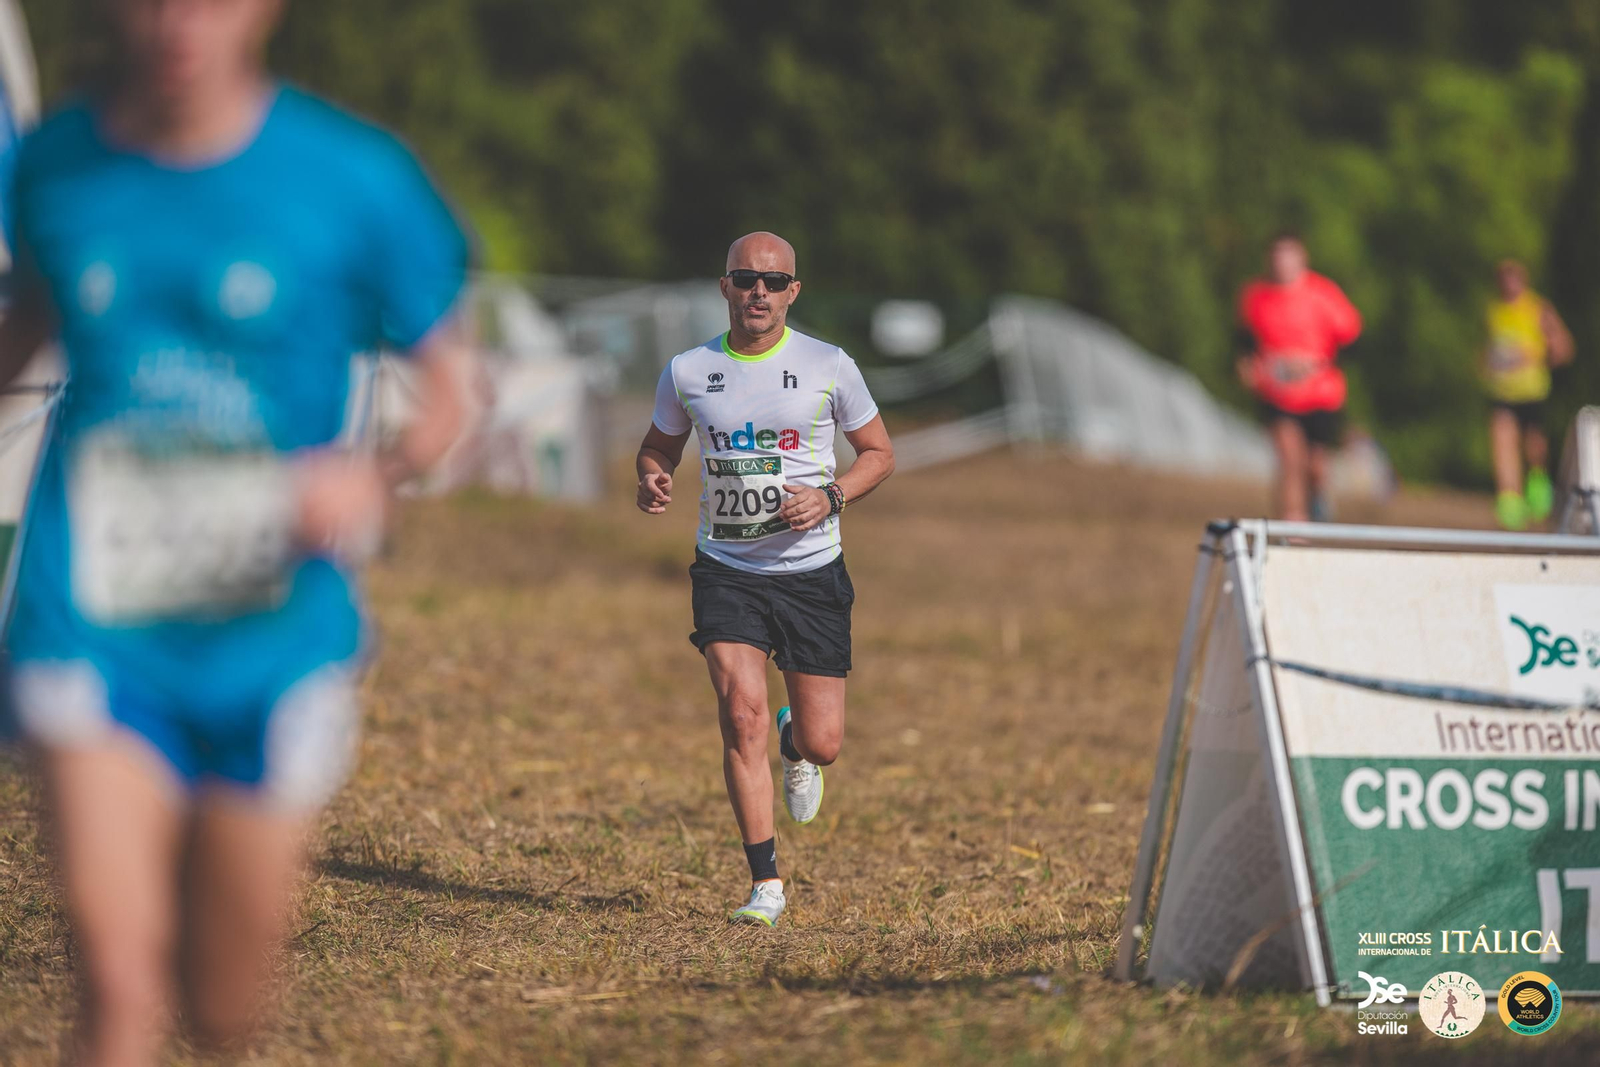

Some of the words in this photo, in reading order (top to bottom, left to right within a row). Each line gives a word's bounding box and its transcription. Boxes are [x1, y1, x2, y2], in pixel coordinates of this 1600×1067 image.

[783, 370, 797, 388] in
[708, 421, 800, 452] indea
[714, 485, 782, 516] 2209
[1341, 767, 1550, 831] CROSS
